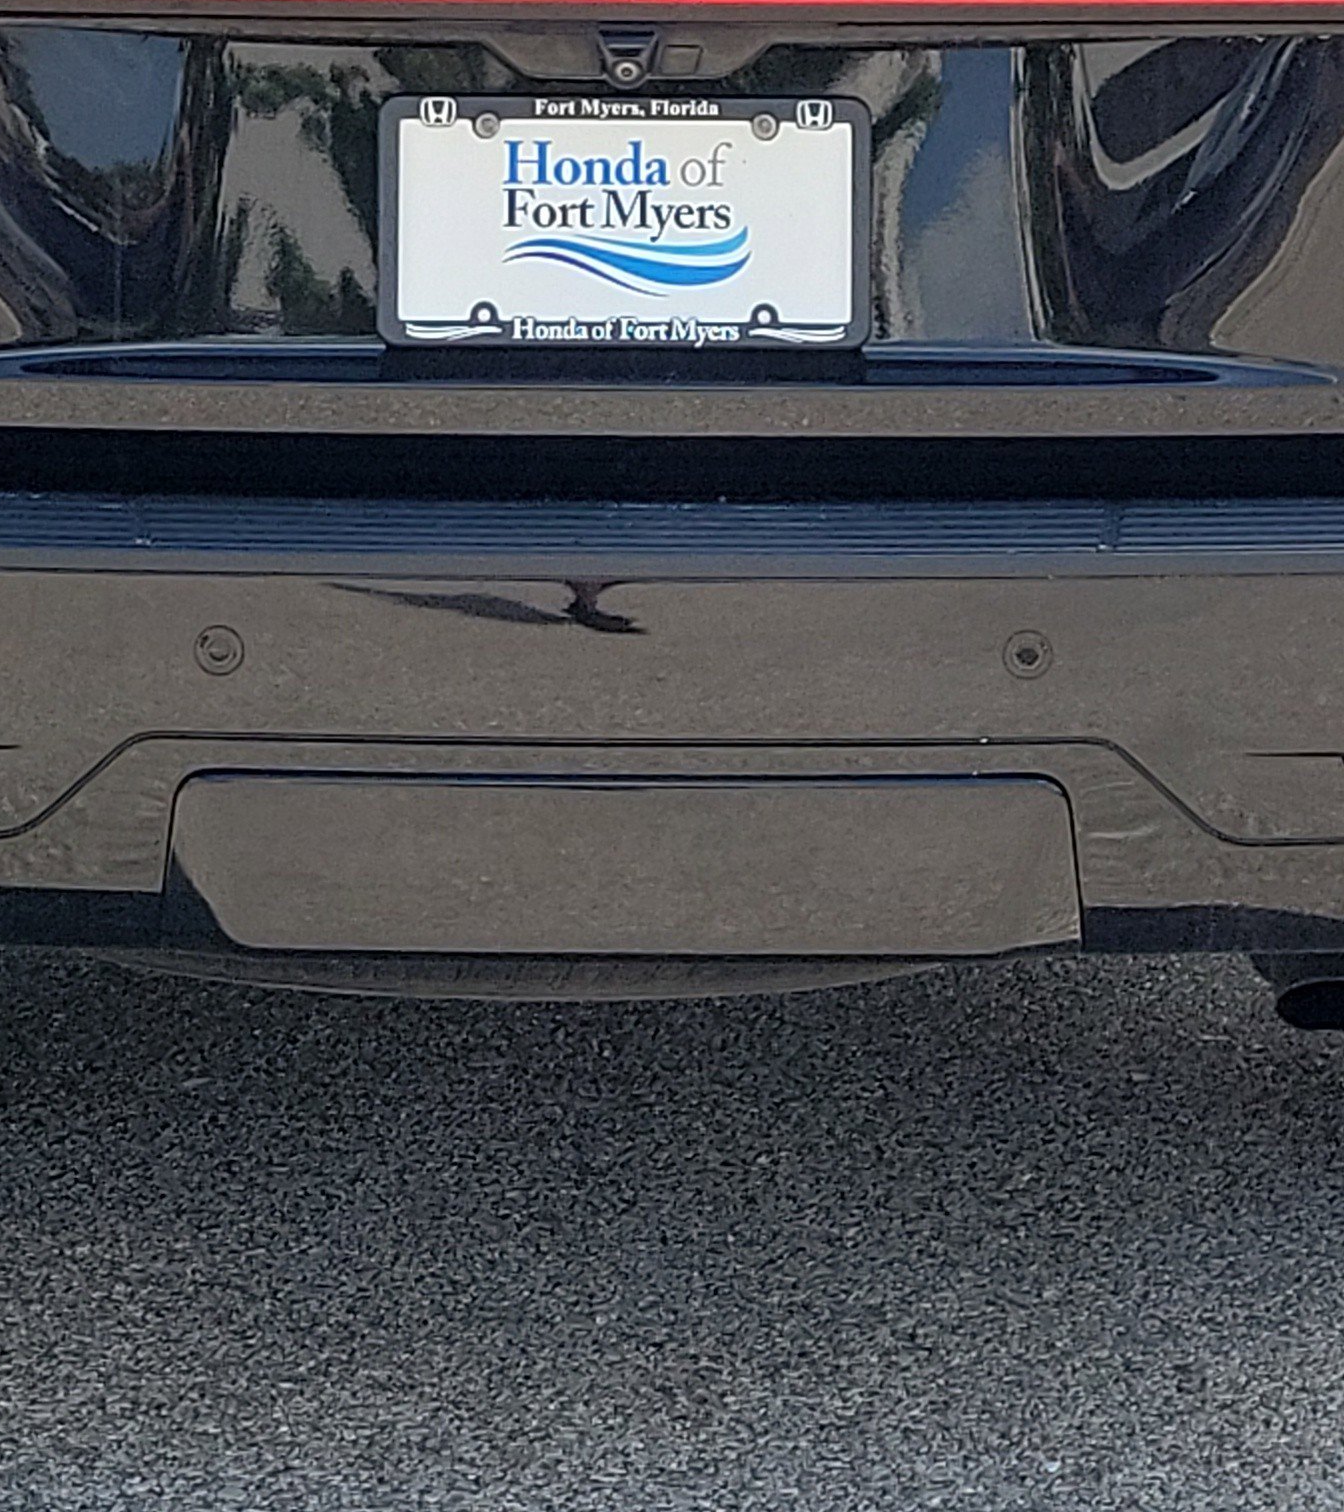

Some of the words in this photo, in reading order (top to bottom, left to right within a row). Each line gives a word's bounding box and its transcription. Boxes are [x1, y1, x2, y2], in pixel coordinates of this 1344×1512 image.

[534, 99, 576, 117] Fort
[580, 99, 646, 120] Myers,
[650, 99, 719, 117] Florida
[503, 140, 670, 186] Honda
[680, 142, 733, 186] of
[502, 189, 595, 229] Fort
[602, 190, 732, 242] Myers
[512, 317, 589, 340] Honda
[591, 318, 616, 340] of
[619, 317, 668, 340] Fort
[670, 318, 740, 347] Myers
